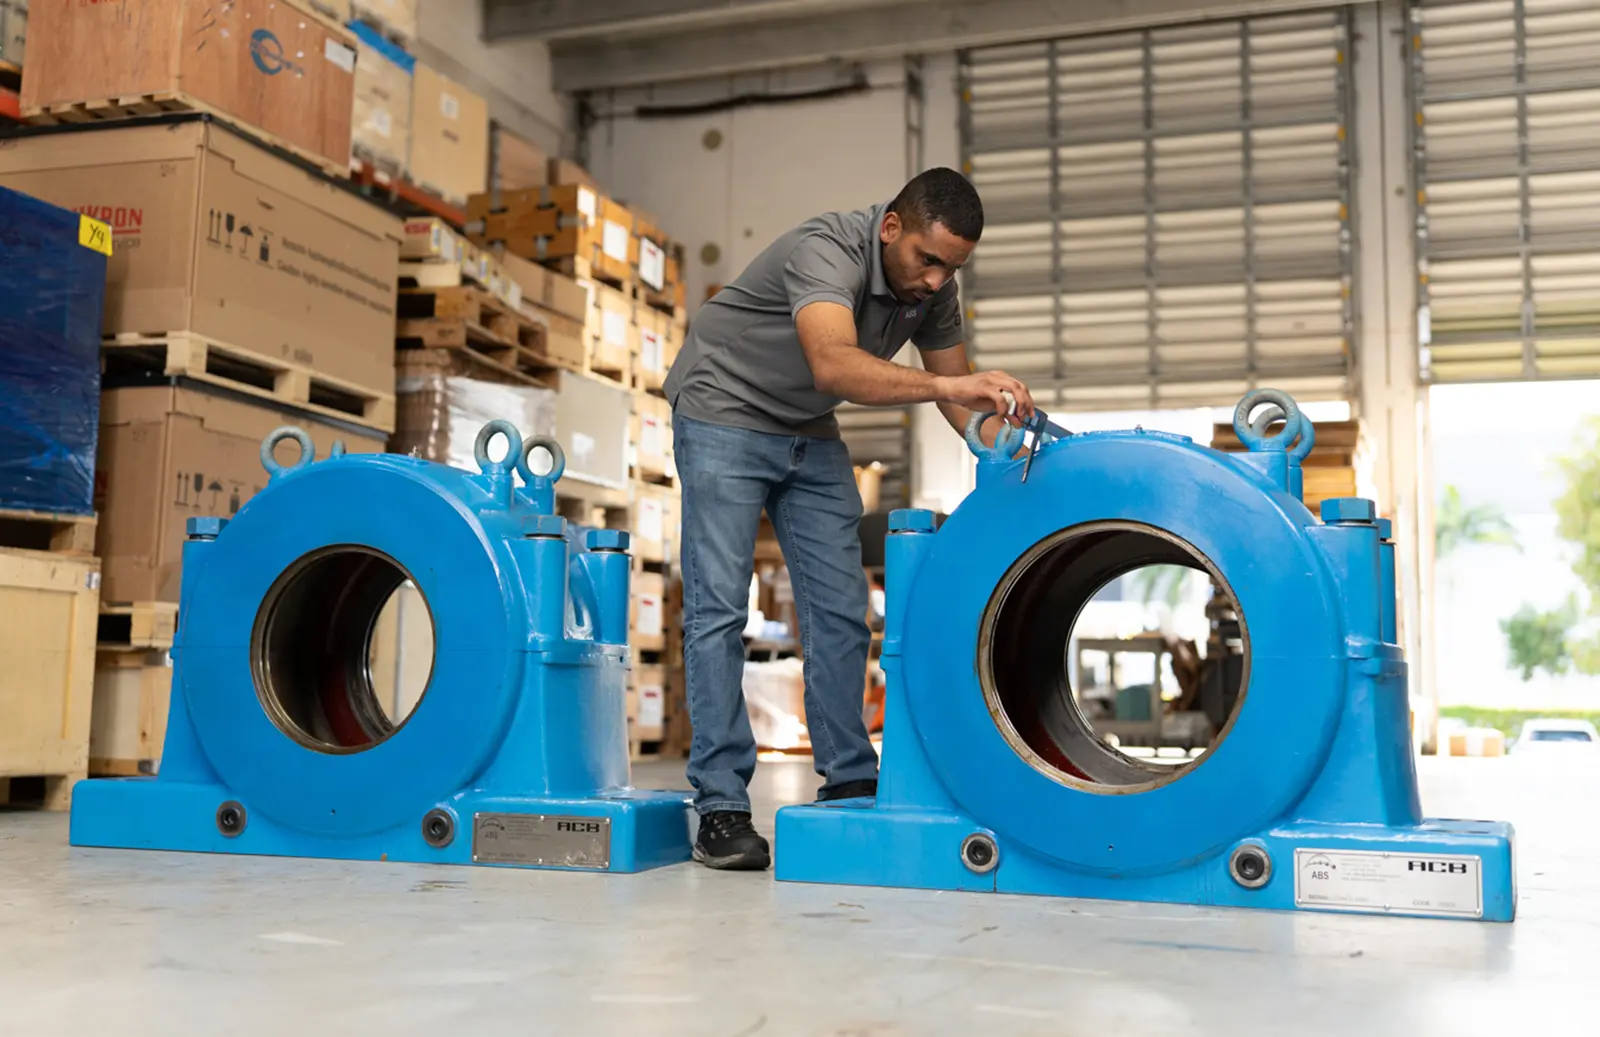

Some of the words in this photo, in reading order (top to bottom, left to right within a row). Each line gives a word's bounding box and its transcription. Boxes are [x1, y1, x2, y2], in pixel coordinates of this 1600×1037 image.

[557, 822, 600, 833] ACB
[1408, 860, 1467, 874] ACB
[1311, 870, 1329, 880] ABS
